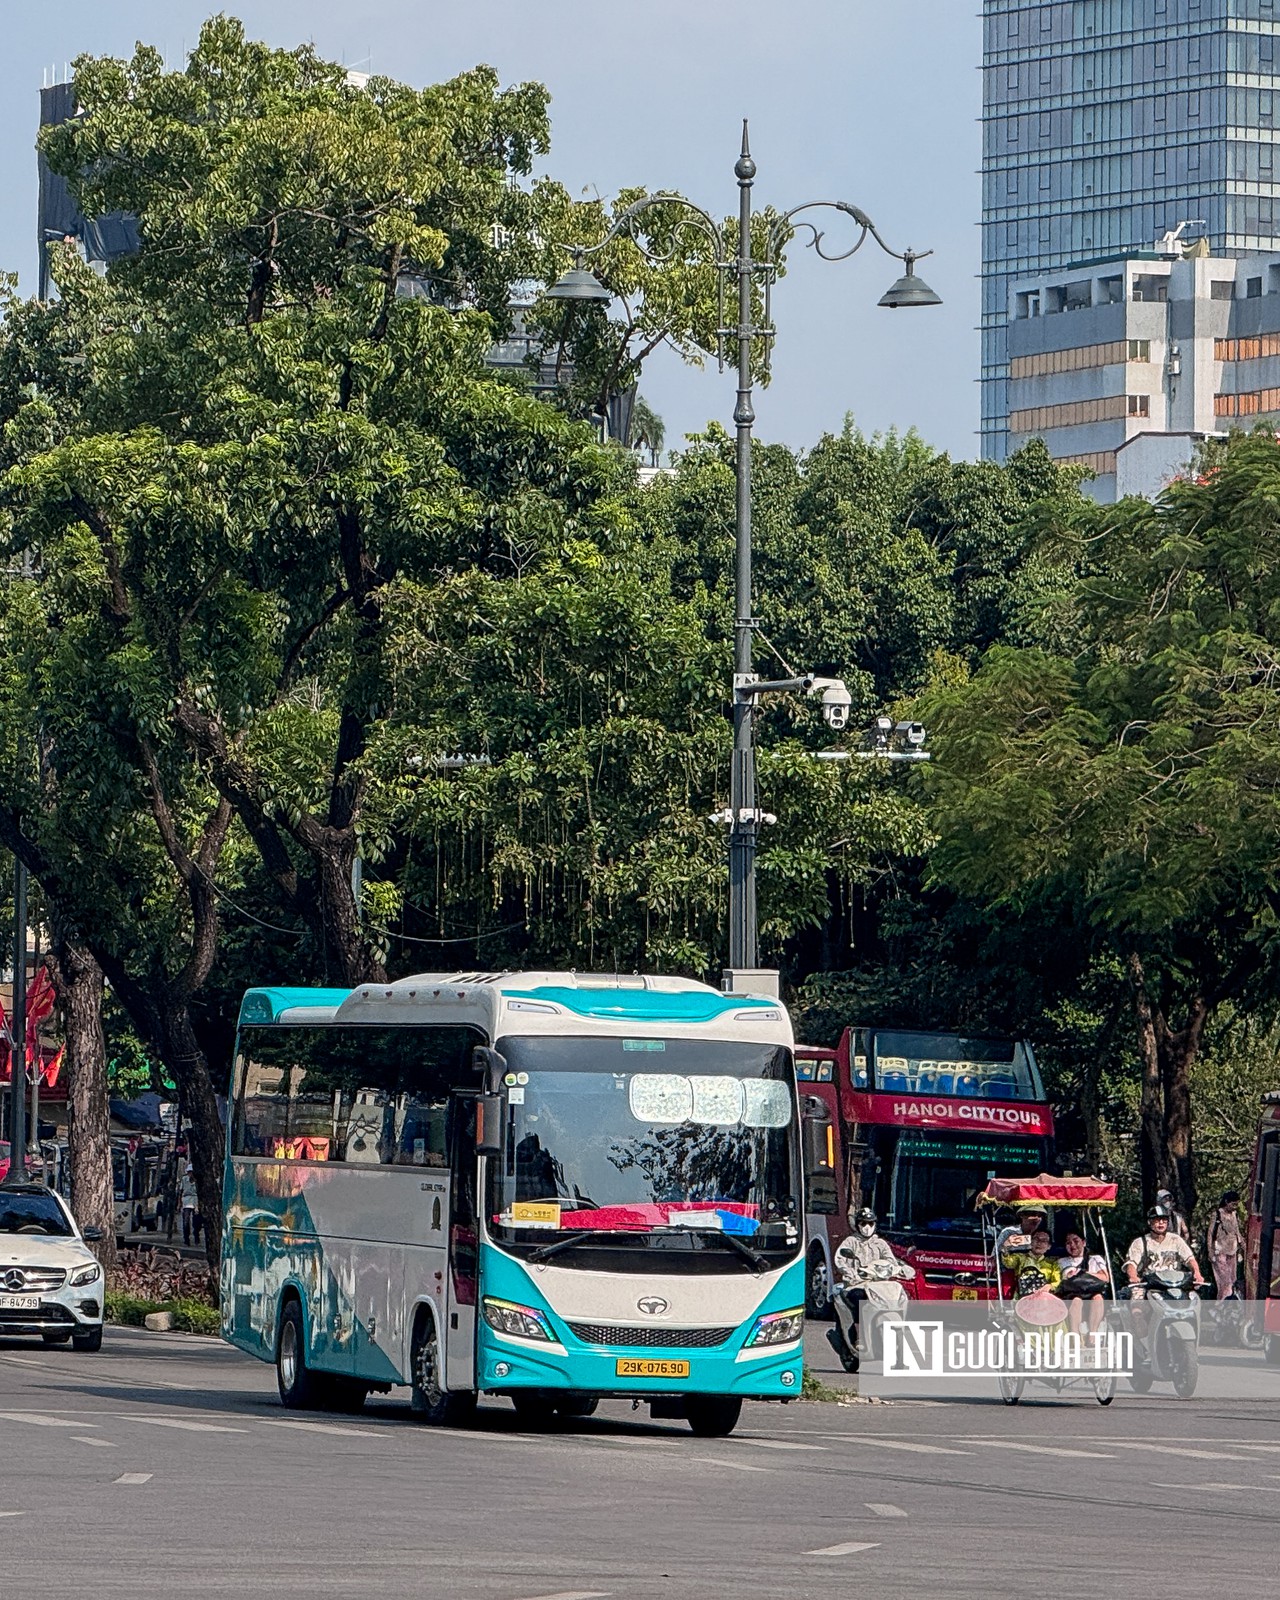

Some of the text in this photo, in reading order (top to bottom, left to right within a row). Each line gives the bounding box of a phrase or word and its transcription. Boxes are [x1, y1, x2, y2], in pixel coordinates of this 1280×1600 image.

[893, 1102, 1041, 1126] HANOI CITYTOUR
[623, 1361, 684, 1373] 29K-076.90
